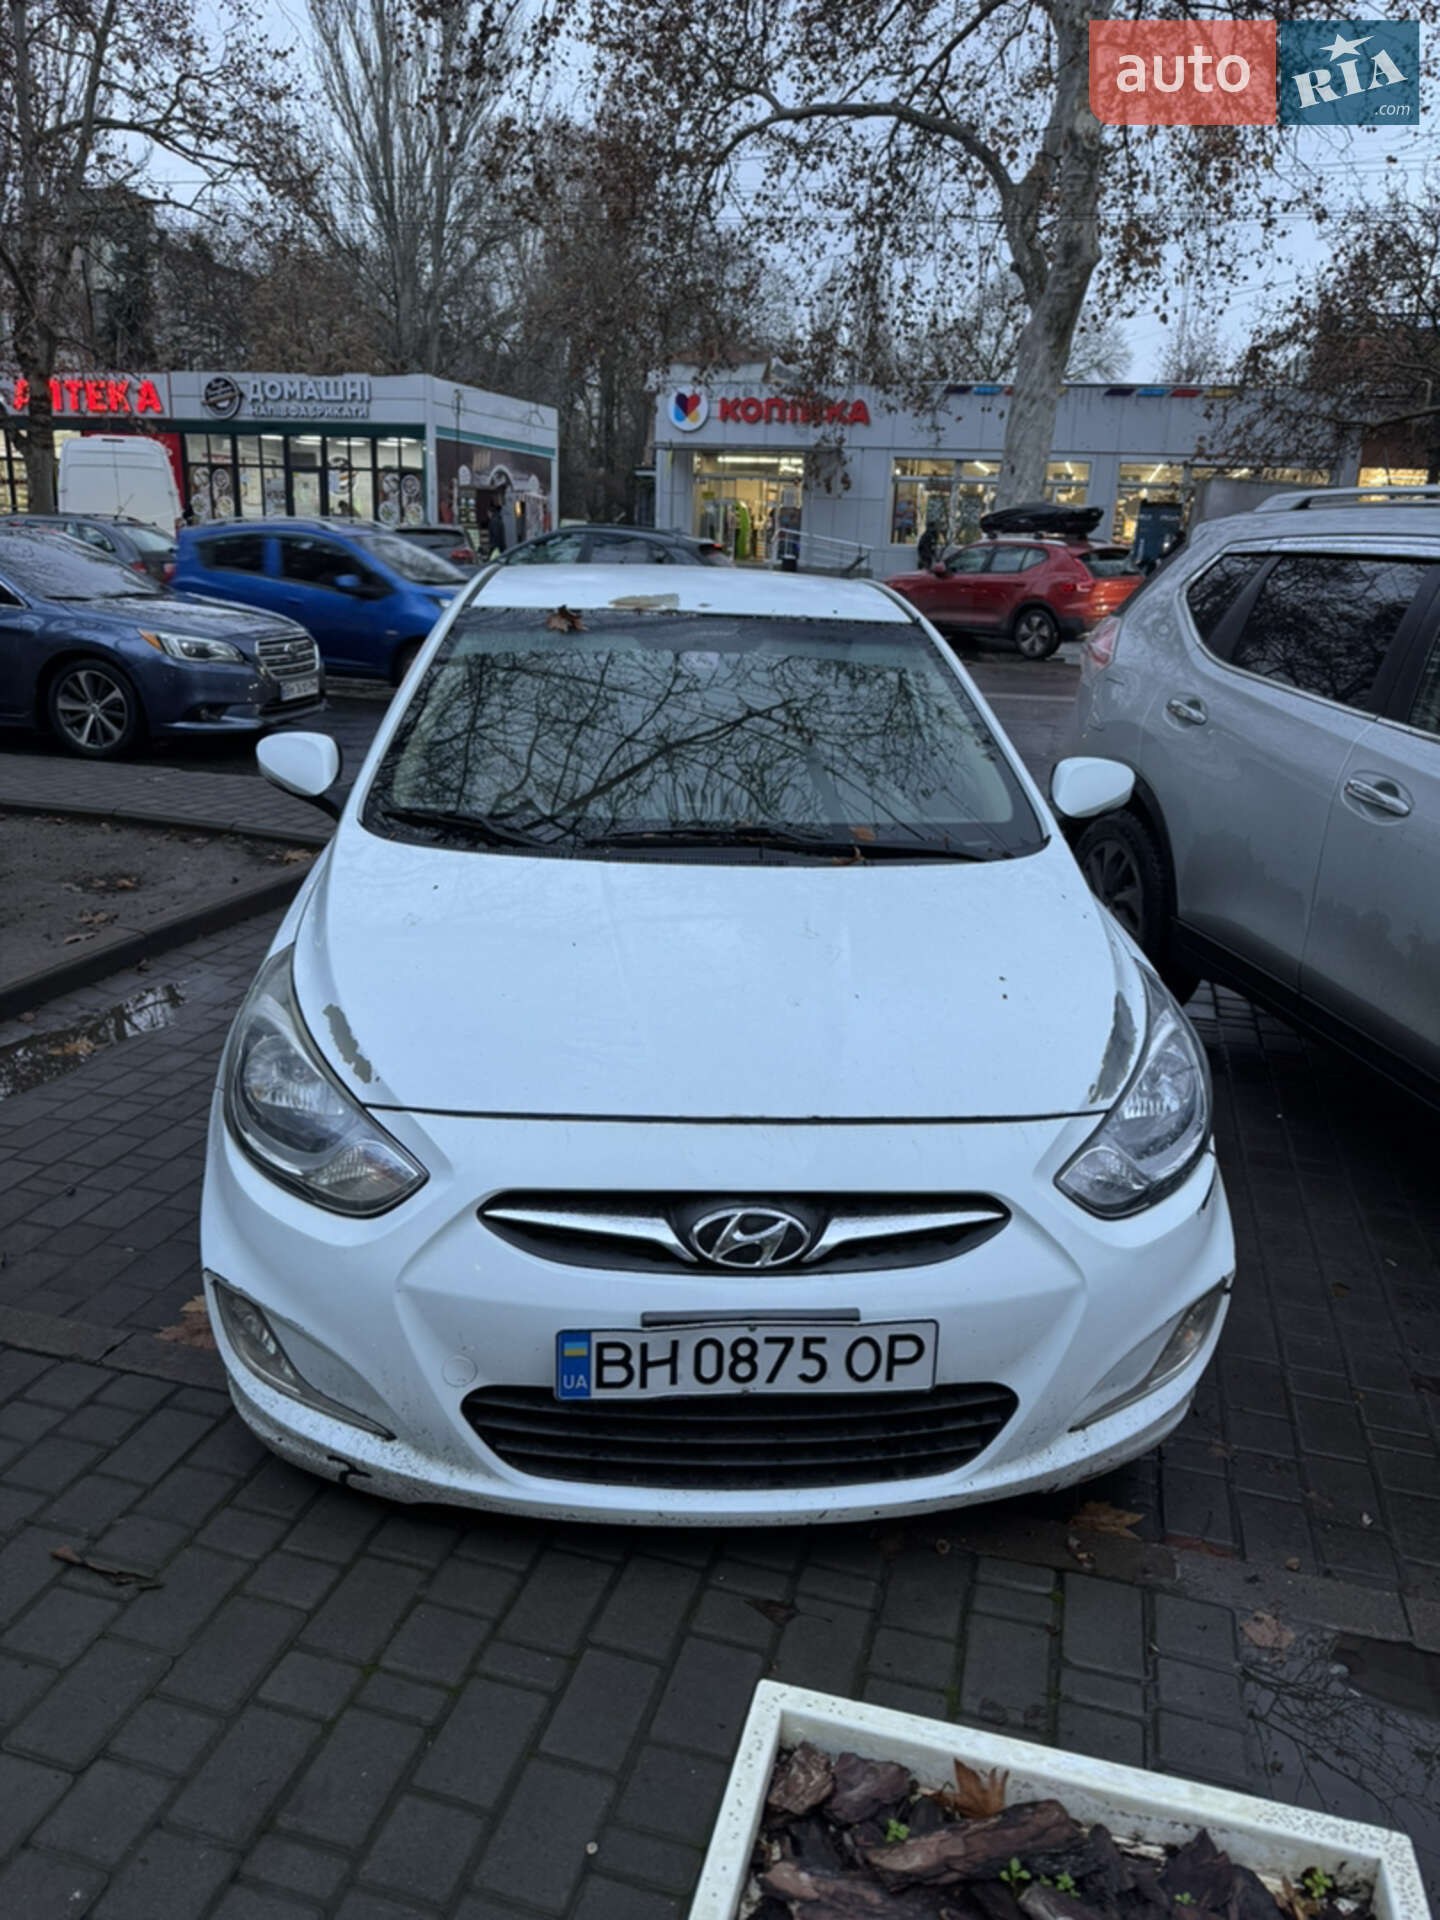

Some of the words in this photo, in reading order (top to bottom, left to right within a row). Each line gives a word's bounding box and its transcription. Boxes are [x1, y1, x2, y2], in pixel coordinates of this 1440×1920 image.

[248, 379, 371, 403] ДОМАШНІ
[595, 1339, 680, 1389] BH
[693, 1336, 828, 1386] 0875
[844, 1333, 926, 1383] OP
[563, 1374, 588, 1390] UA
